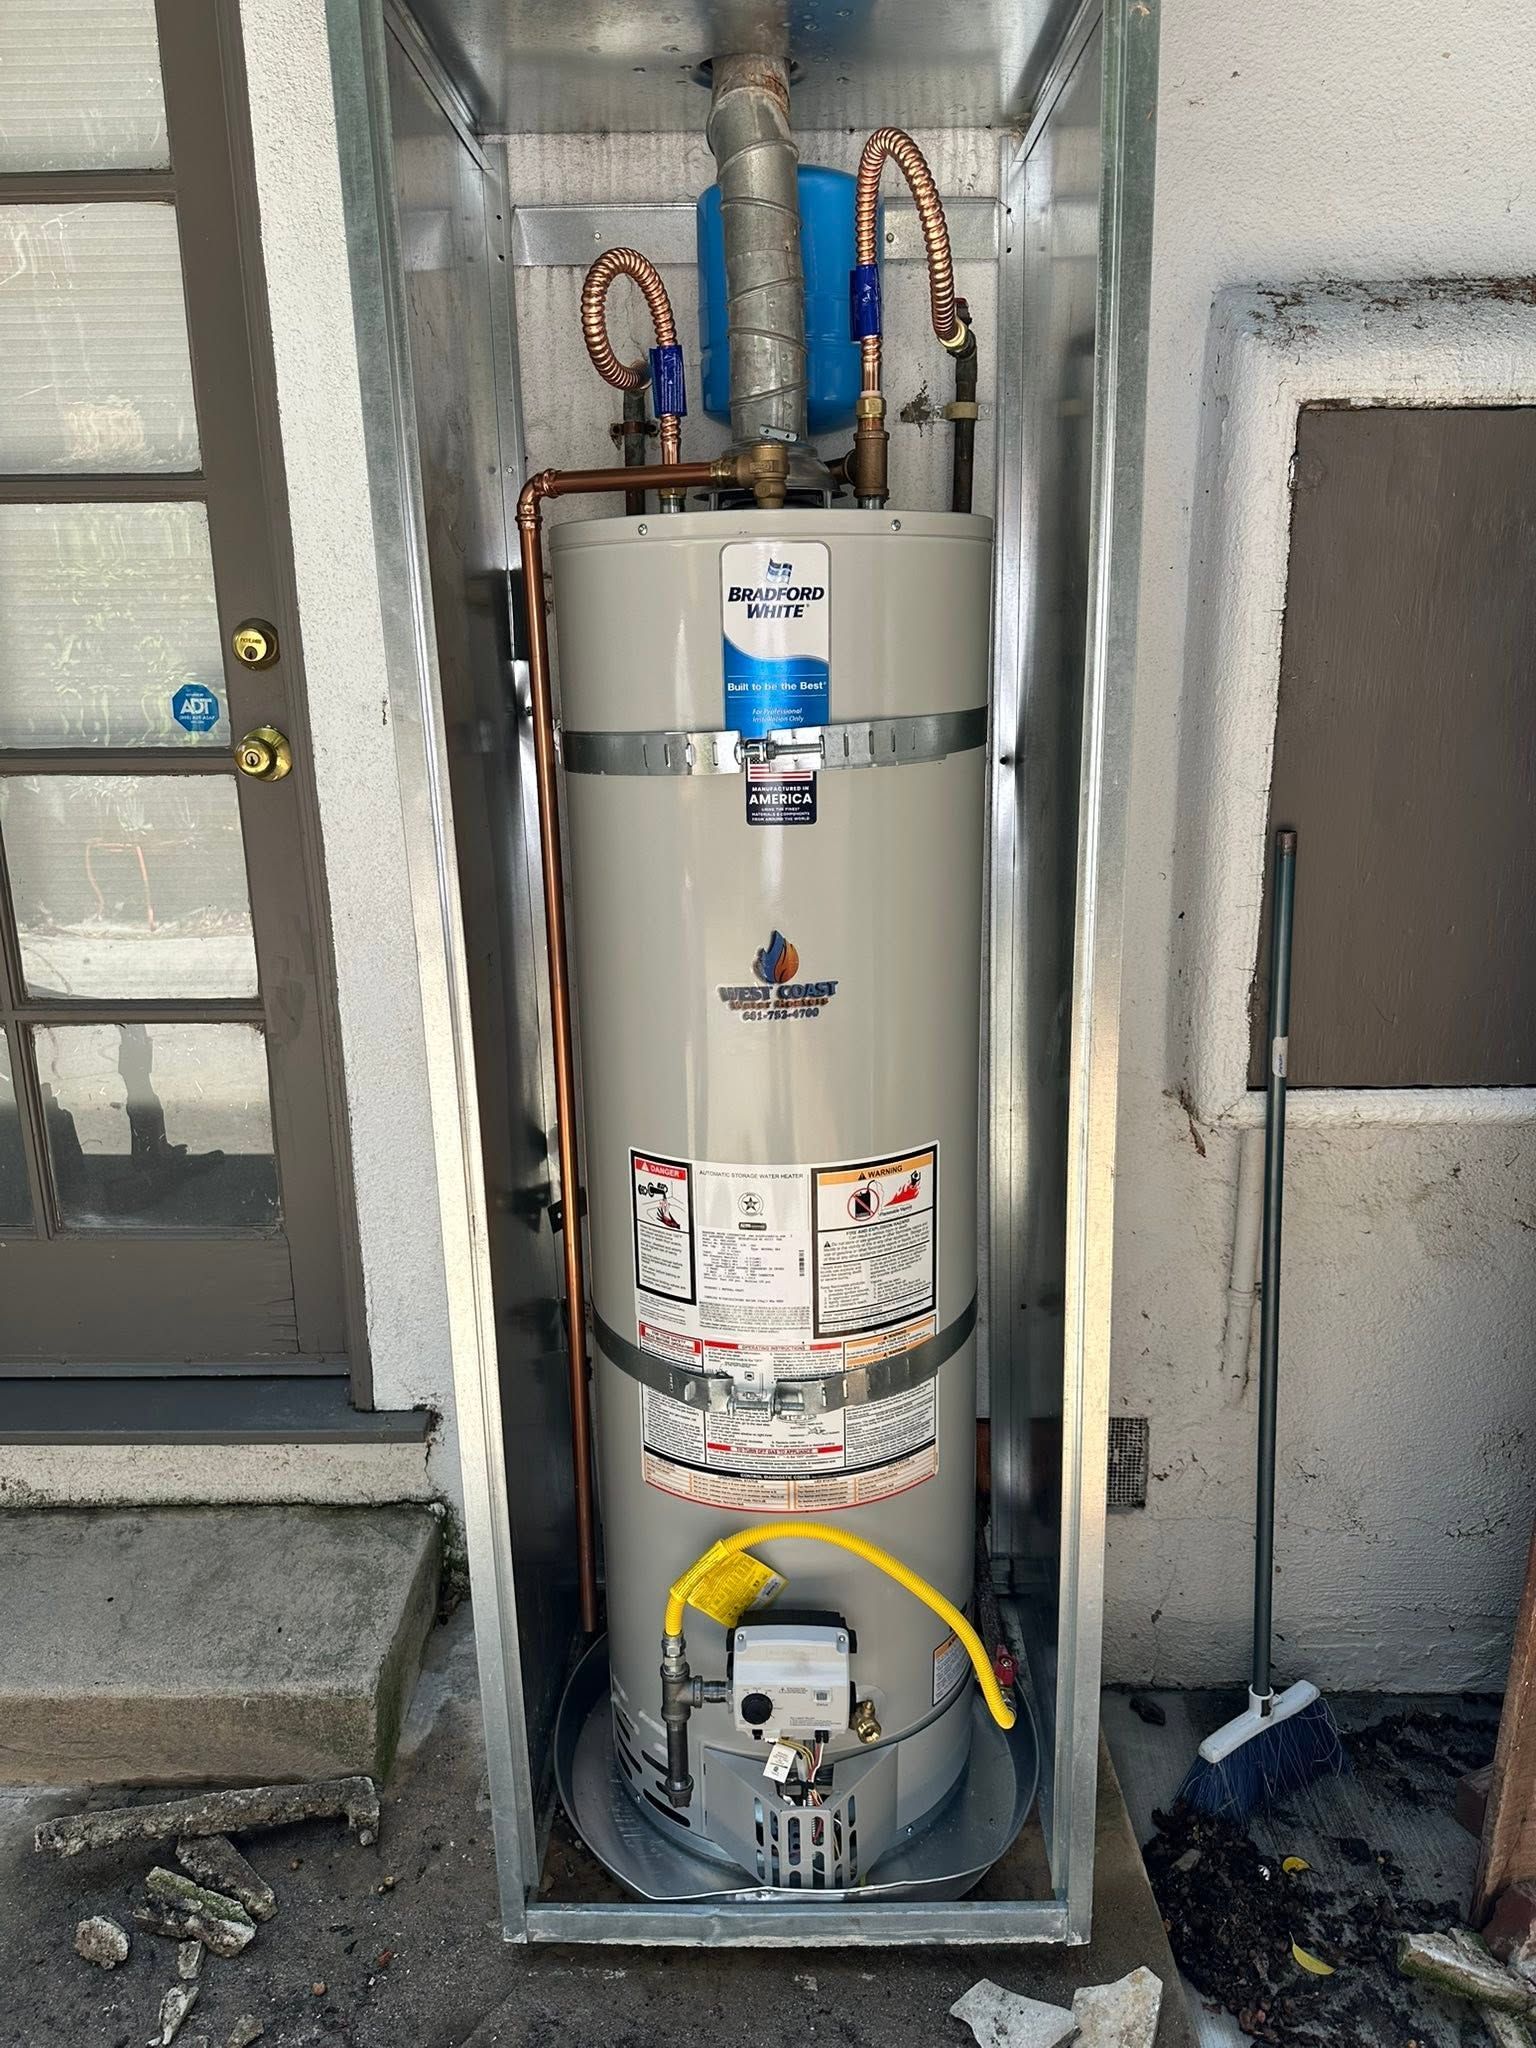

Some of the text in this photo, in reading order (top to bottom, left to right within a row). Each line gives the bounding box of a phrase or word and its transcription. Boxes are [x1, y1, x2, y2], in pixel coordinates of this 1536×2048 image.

[727, 586, 825, 602] BRADFORD
[747, 603, 806, 619] WHITE
[727, 681, 823, 691] Built to be the Best
[180, 698, 213, 714] ADT
[763, 707, 803, 716] Professional
[789, 716, 804, 724] Only
[749, 793, 813, 805] AMERICA
[719, 981, 839, 1001] WEST COAST
[650, 1165, 685, 1179] DANGER
[699, 1170, 730, 1178] AUTOMATIC
[868, 1165, 903, 1178] WARNING
